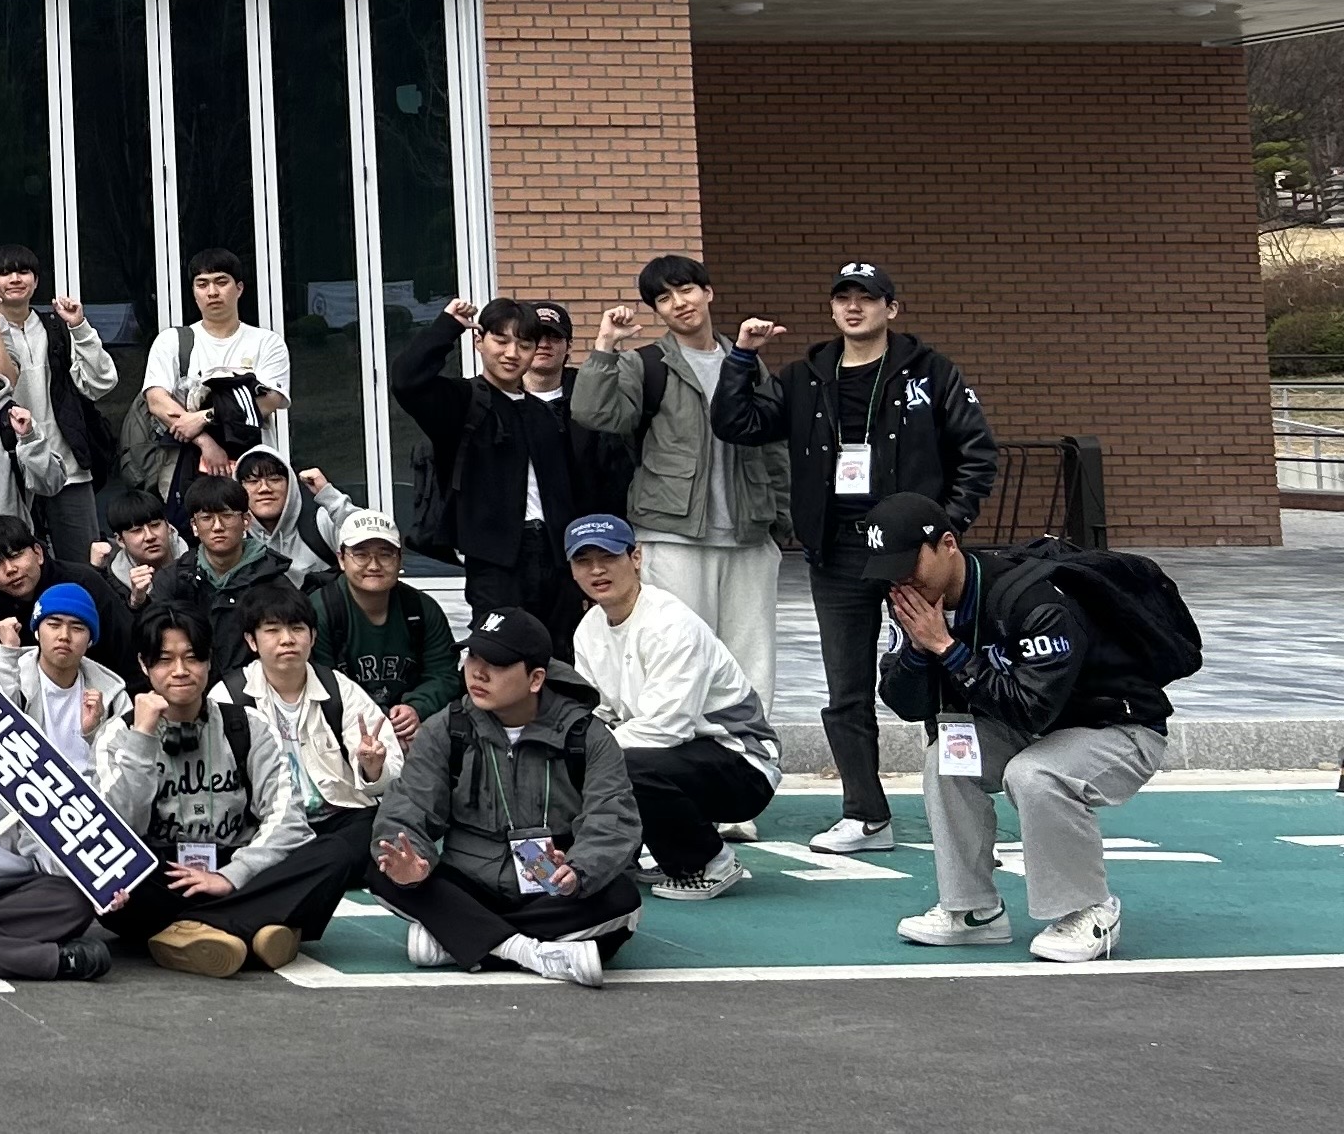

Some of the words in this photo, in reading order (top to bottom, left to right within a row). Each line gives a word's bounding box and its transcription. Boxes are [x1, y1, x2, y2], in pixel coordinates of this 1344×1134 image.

[353, 516, 391, 530] BOSTON
[1019, 635, 1071, 658] 30th
[156, 759, 241, 800] ndless
